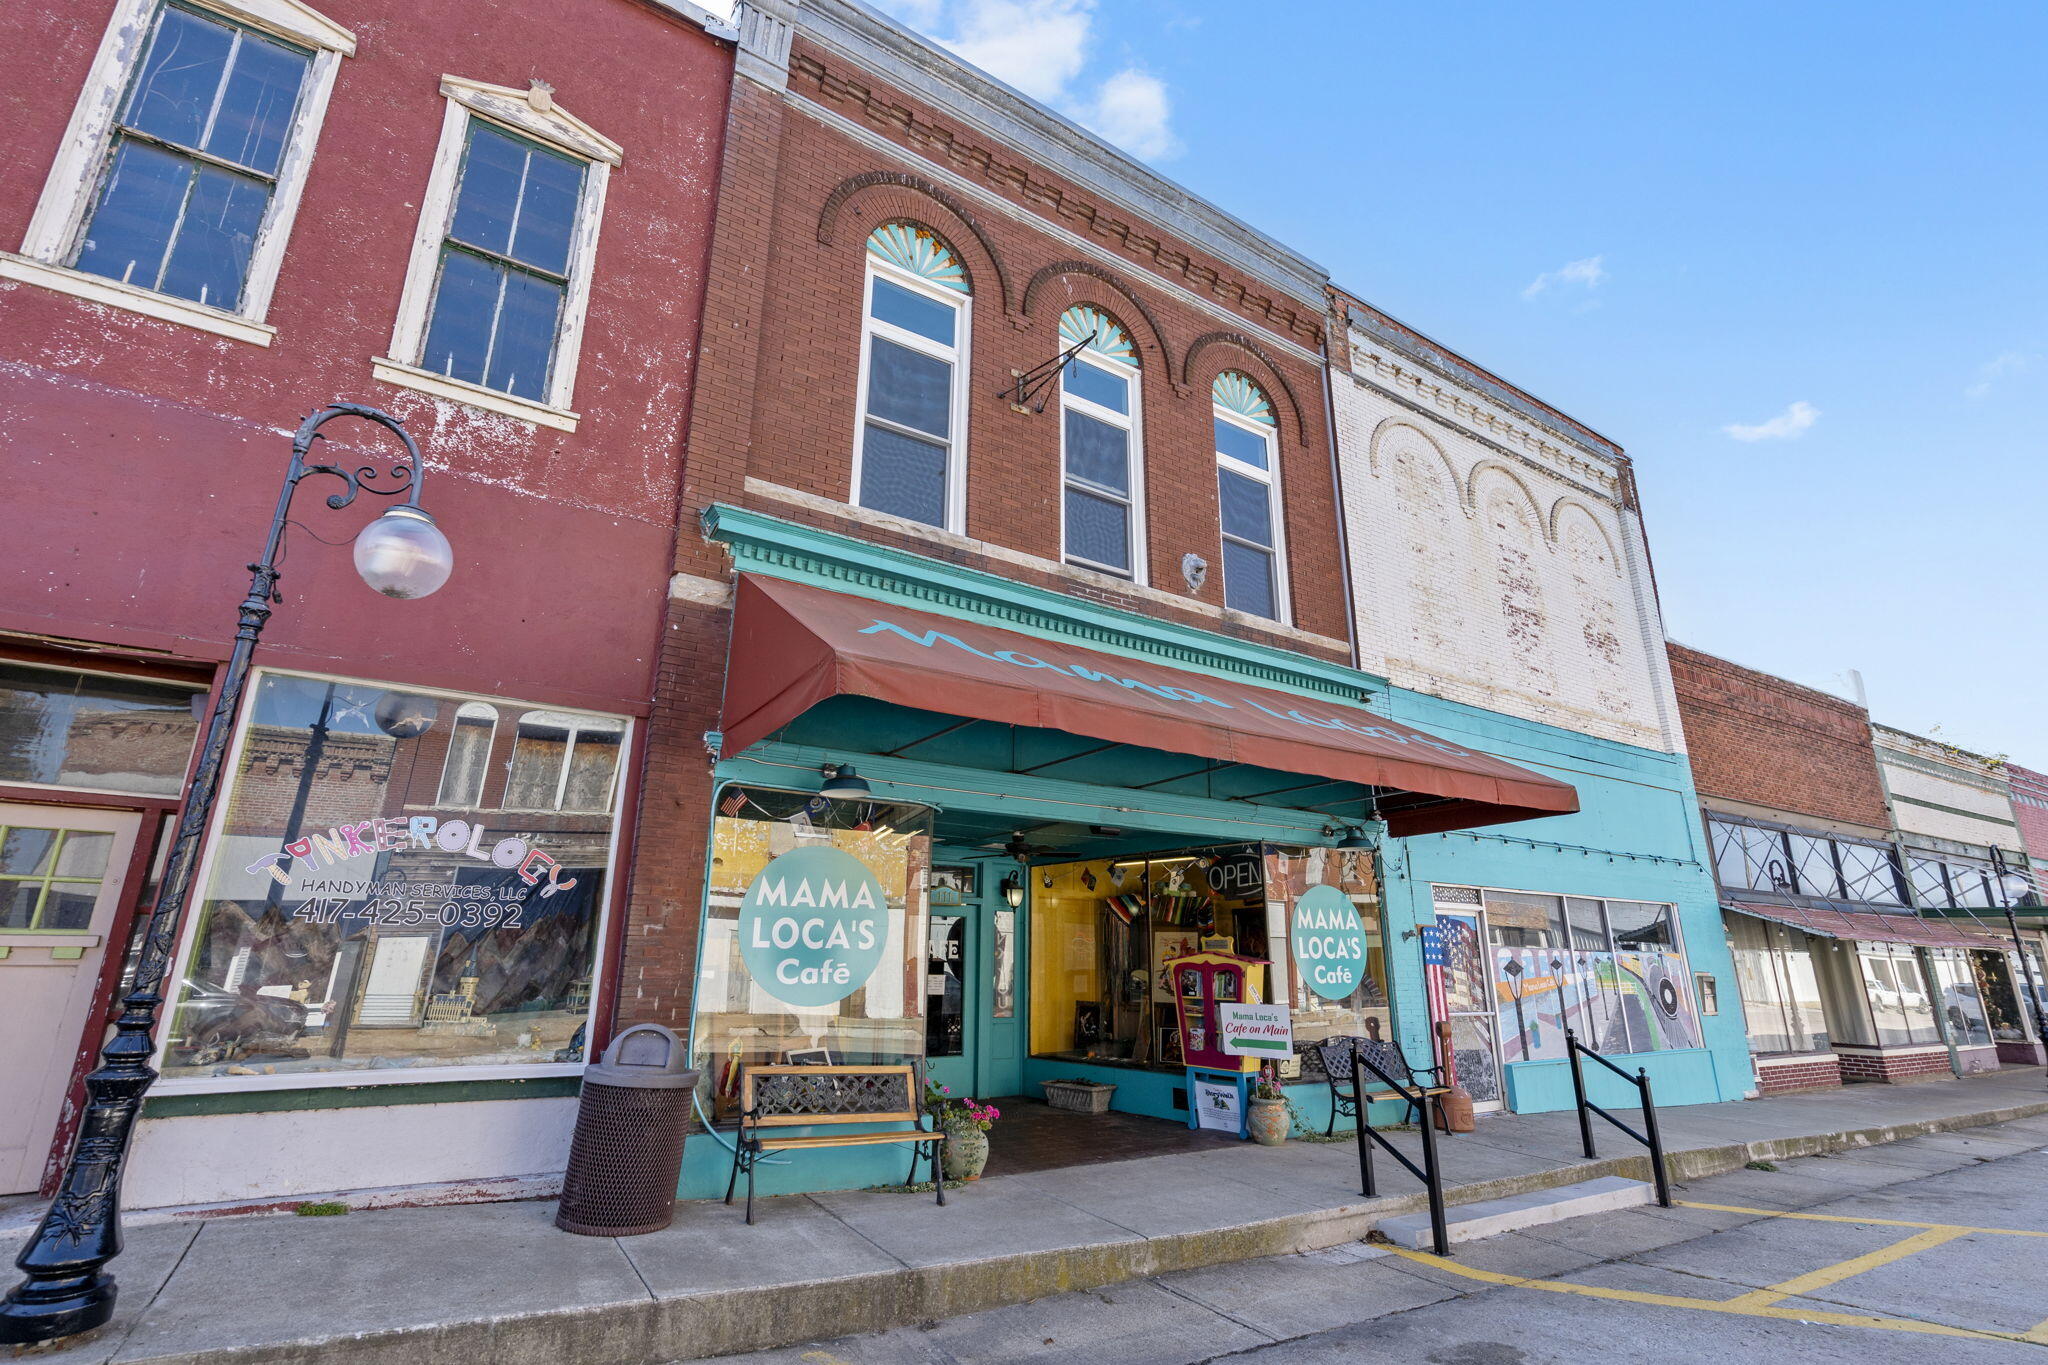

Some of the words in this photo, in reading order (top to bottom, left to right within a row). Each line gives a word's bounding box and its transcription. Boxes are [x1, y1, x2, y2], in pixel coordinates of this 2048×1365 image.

[857, 619, 1235, 709] Mama
[1209, 861, 1262, 890] OPEN
[301, 878, 406, 896] HANDYMAN
[410, 883, 495, 902] SERVICES,
[498, 886, 527, 900] LLC
[755, 875, 876, 910] MAMA
[293, 896, 523, 929] 417-425-0392
[1297, 906, 1358, 930] MAMA
[752, 917, 875, 950] LOCA'S
[1298, 936, 1361, 959] LOCA'S
[1225, 1022, 1248, 1036] Cafe
[1249, 1025, 1261, 1034] on
[1262, 1024, 1289, 1036] Main
[1232, 1011, 1254, 1020] Mama
[1255, 1012, 1279, 1021] Loca's
